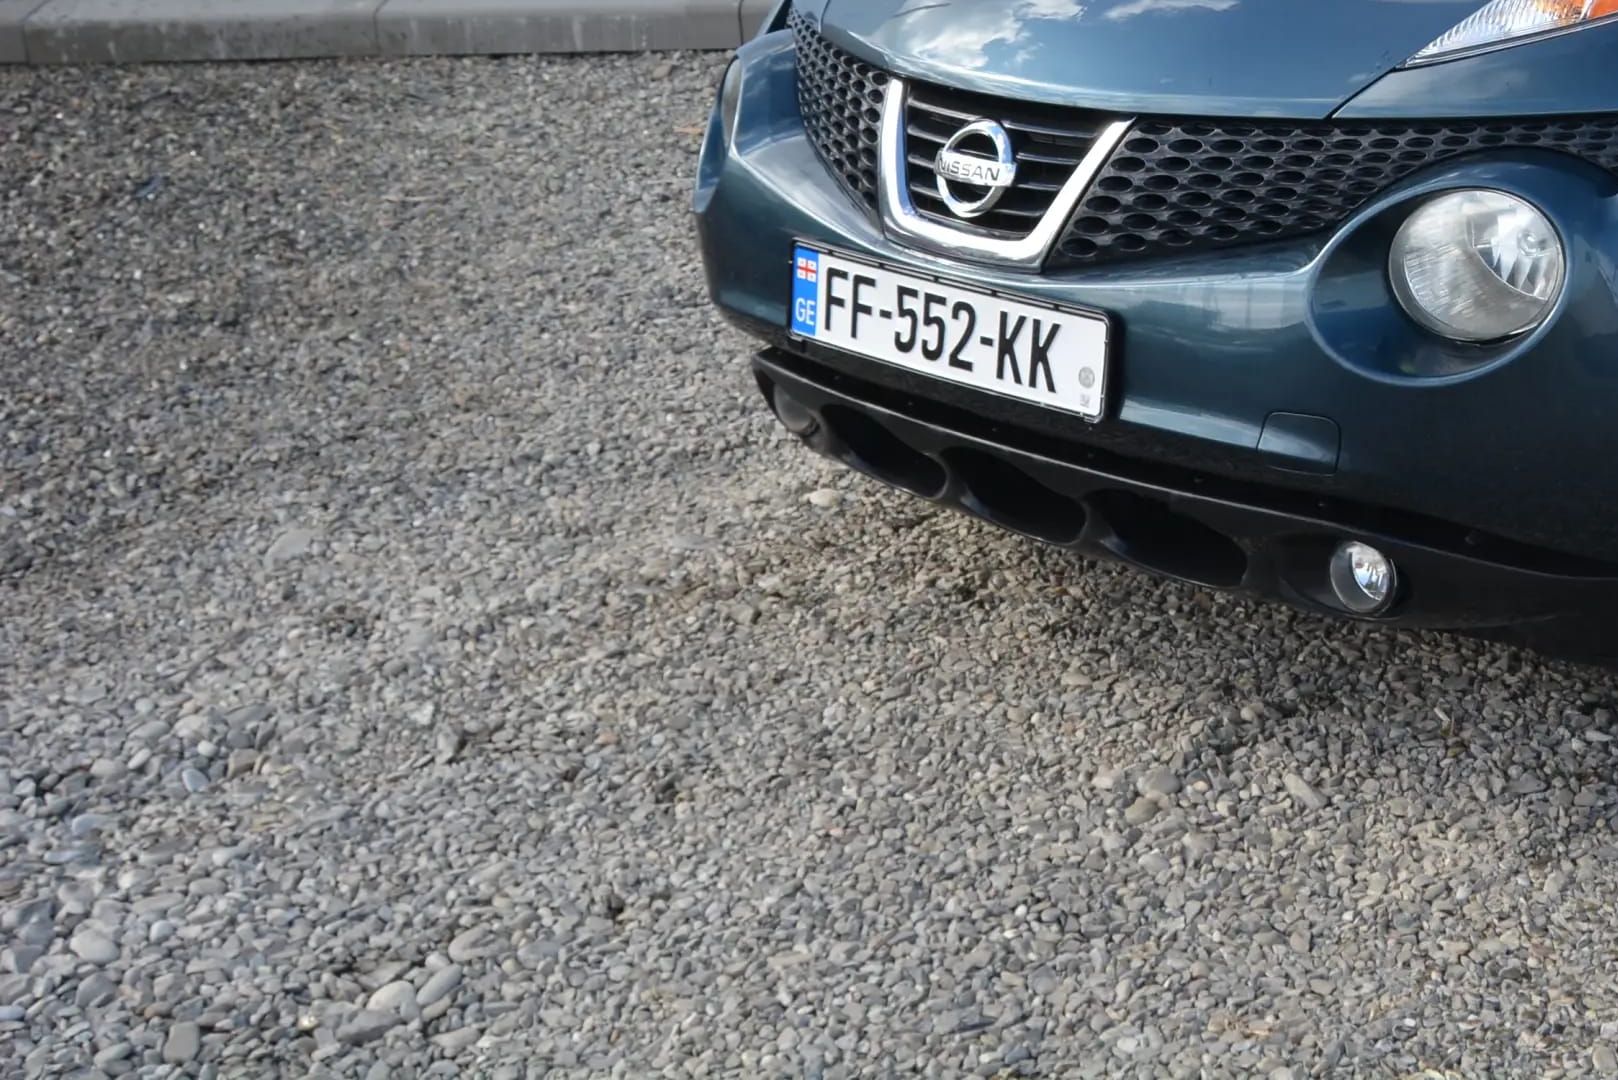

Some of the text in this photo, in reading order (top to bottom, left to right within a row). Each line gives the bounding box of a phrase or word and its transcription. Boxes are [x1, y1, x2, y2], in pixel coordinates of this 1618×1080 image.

[939, 158, 1001, 182] NISSAN
[795, 297, 816, 326] GE
[824, 266, 1062, 394] FF-552-KK
